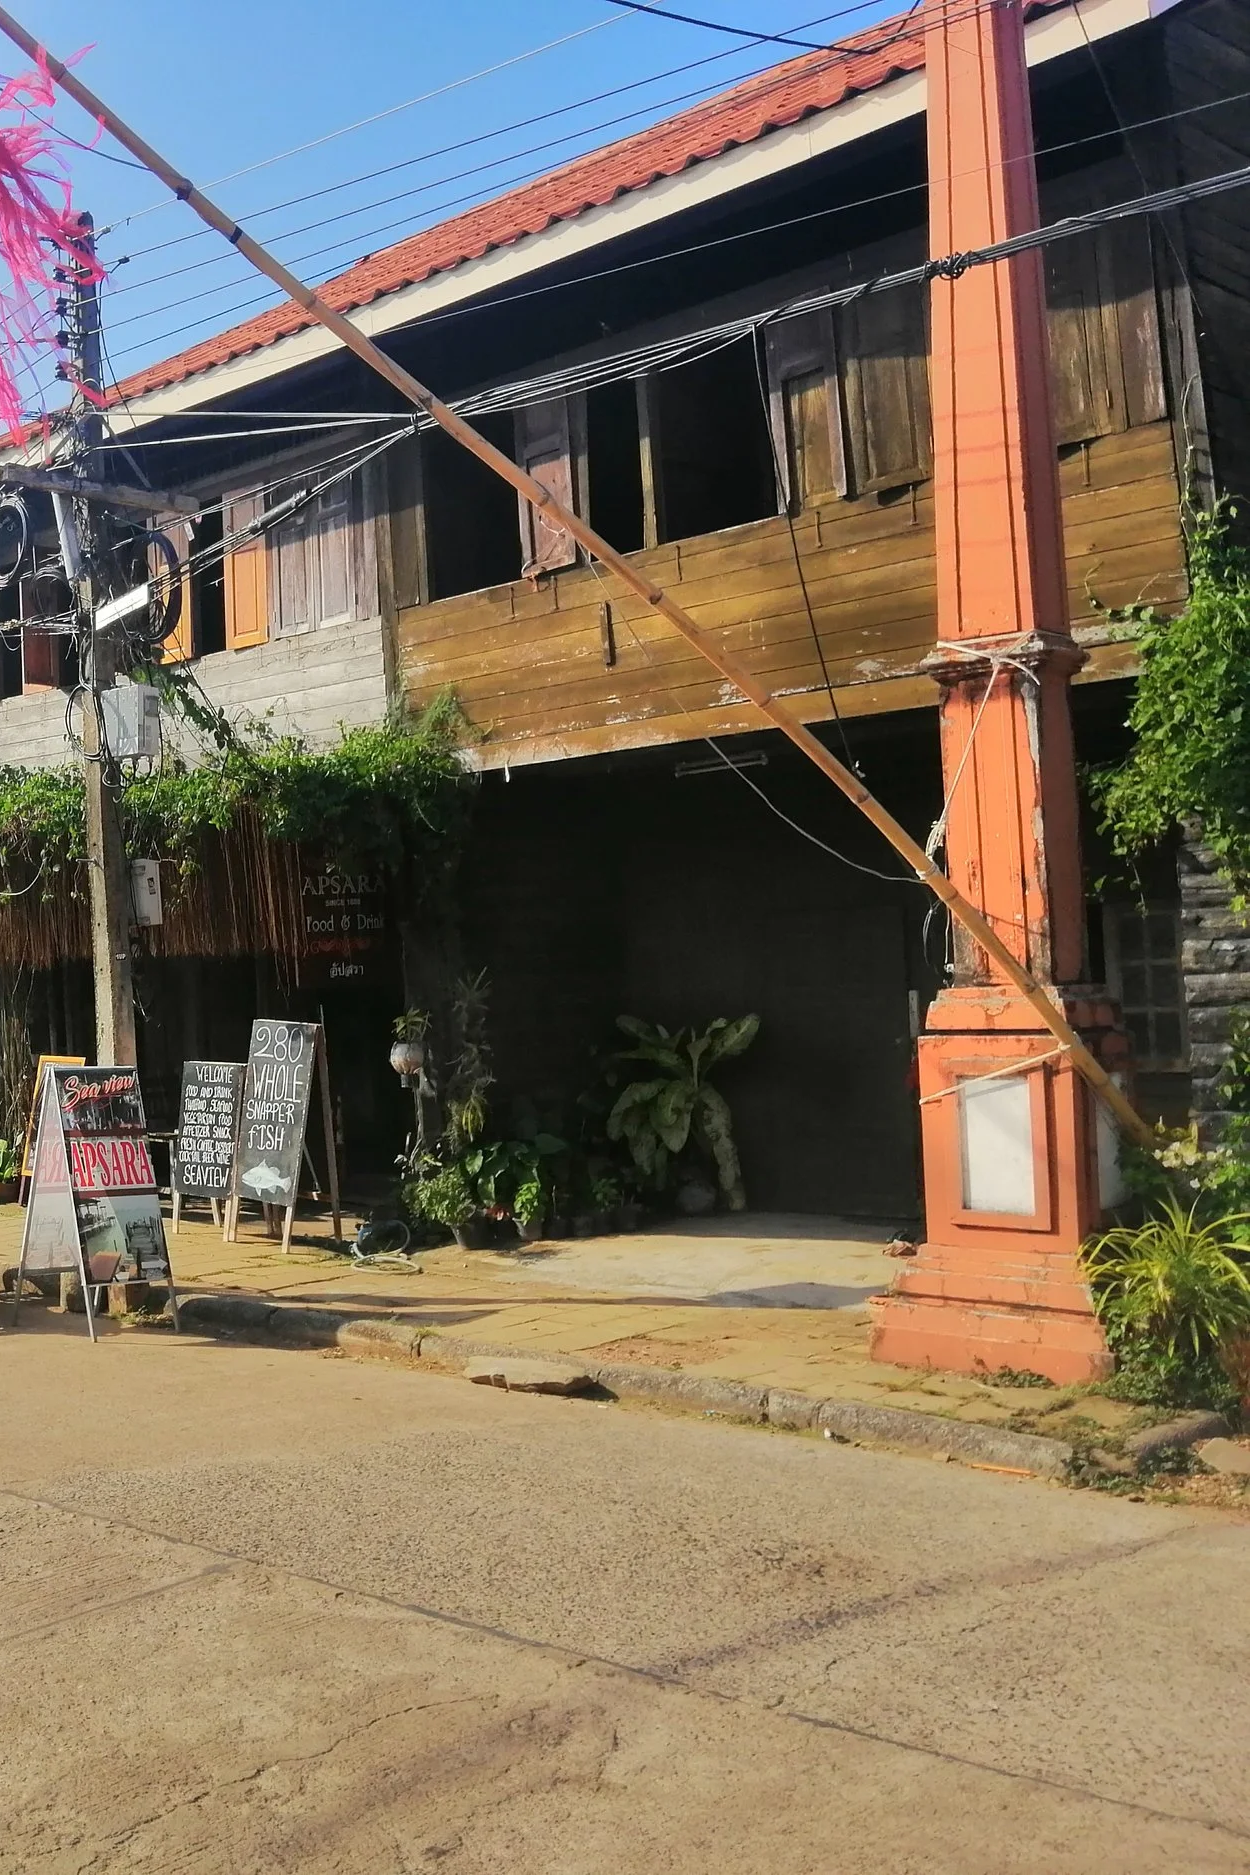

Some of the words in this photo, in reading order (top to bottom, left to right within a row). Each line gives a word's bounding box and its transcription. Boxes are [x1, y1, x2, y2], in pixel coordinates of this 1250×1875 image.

[302, 874, 387, 896] APSARA
[254, 1026, 304, 1063] 280
[61, 1075, 101, 1110] Sea
[196, 1066, 234, 1084] WELCOME
[252, 1063, 304, 1103] WHOLE
[246, 1099, 295, 1125] SNAPPER
[70, 1140, 155, 1187] APSARA
